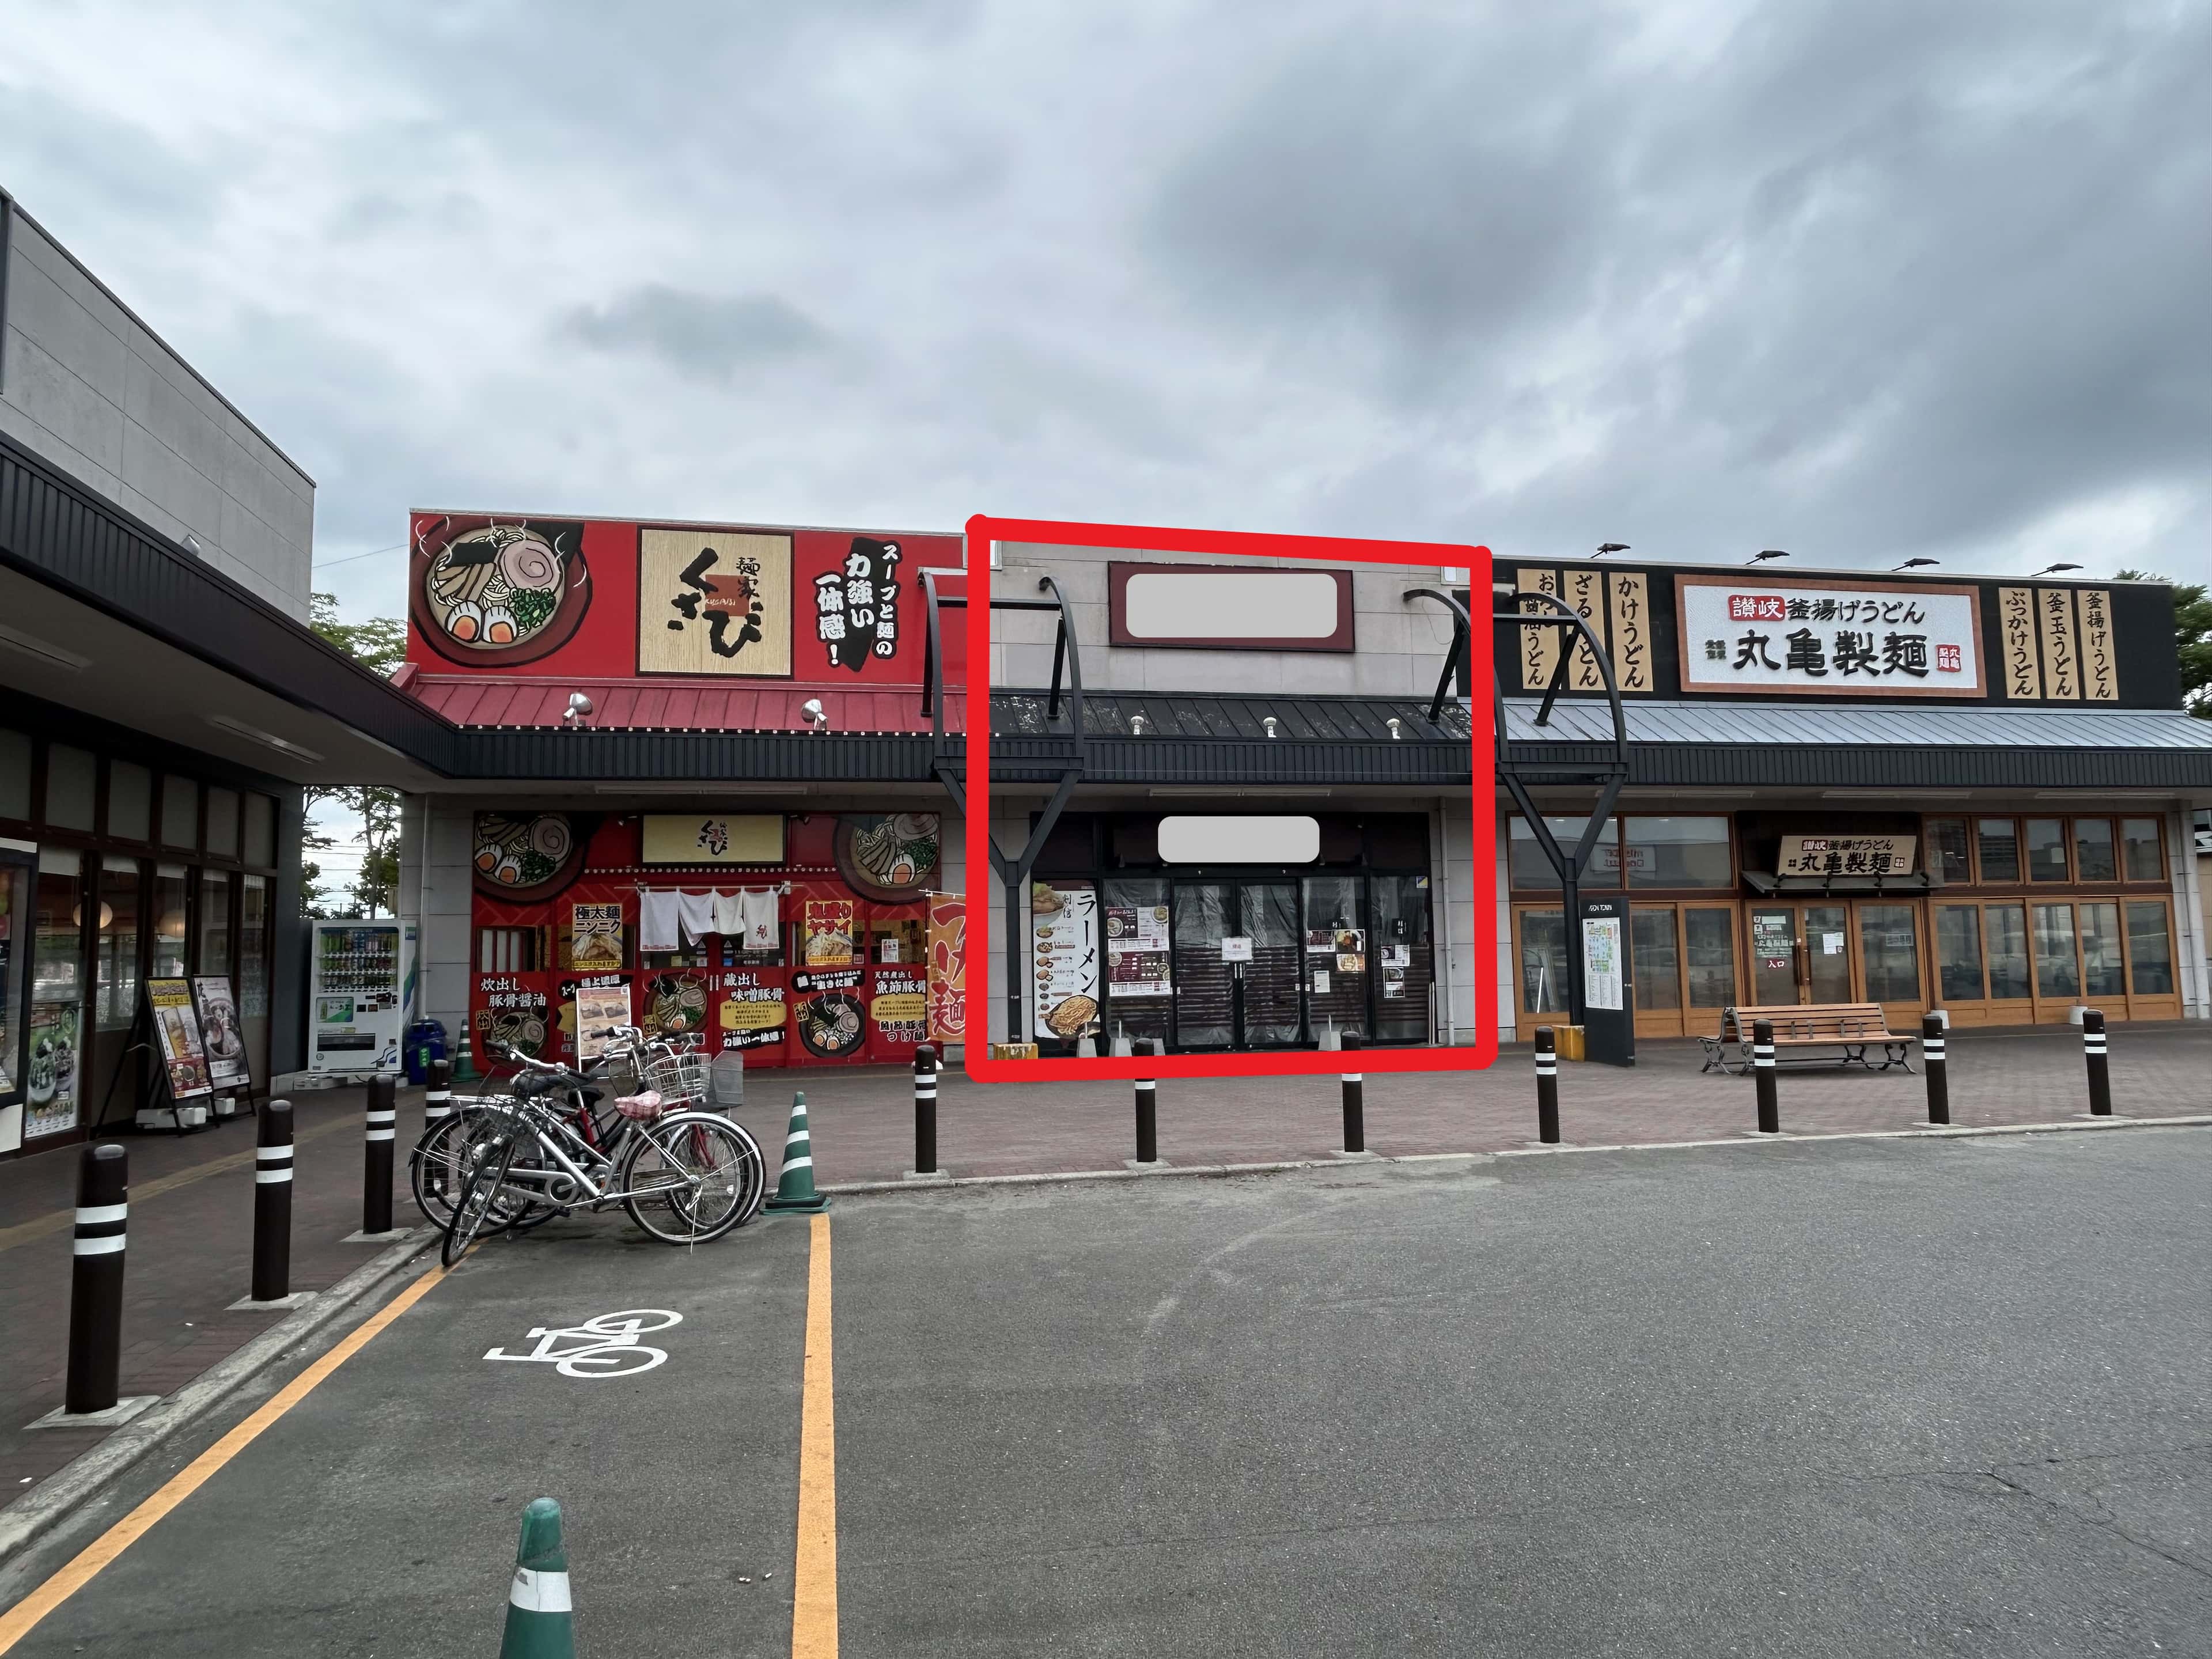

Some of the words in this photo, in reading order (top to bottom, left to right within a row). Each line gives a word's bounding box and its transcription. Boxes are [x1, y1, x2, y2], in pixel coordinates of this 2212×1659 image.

[846, 553, 874, 628] 力強い
[1786, 598, 1925, 624] 釜揚げうどん
[1618, 576, 1644, 688] かけうどん
[1732, 627, 1930, 677] 丸亀製麺
[1798, 851, 1893, 873] 丸亀製麺
[575, 905, 620, 920] 極太麺
[574, 919, 621, 934] ニンニク
[1077, 894, 1097, 994] ラーメン
[1768, 960, 1785, 968] 入口
[480, 977, 521, 991] 炊出し
[723, 972, 760, 987] 蔵出し
[488, 993, 547, 1008] 豚骨醤油
[730, 987, 785, 1002] 味噌豚骨
